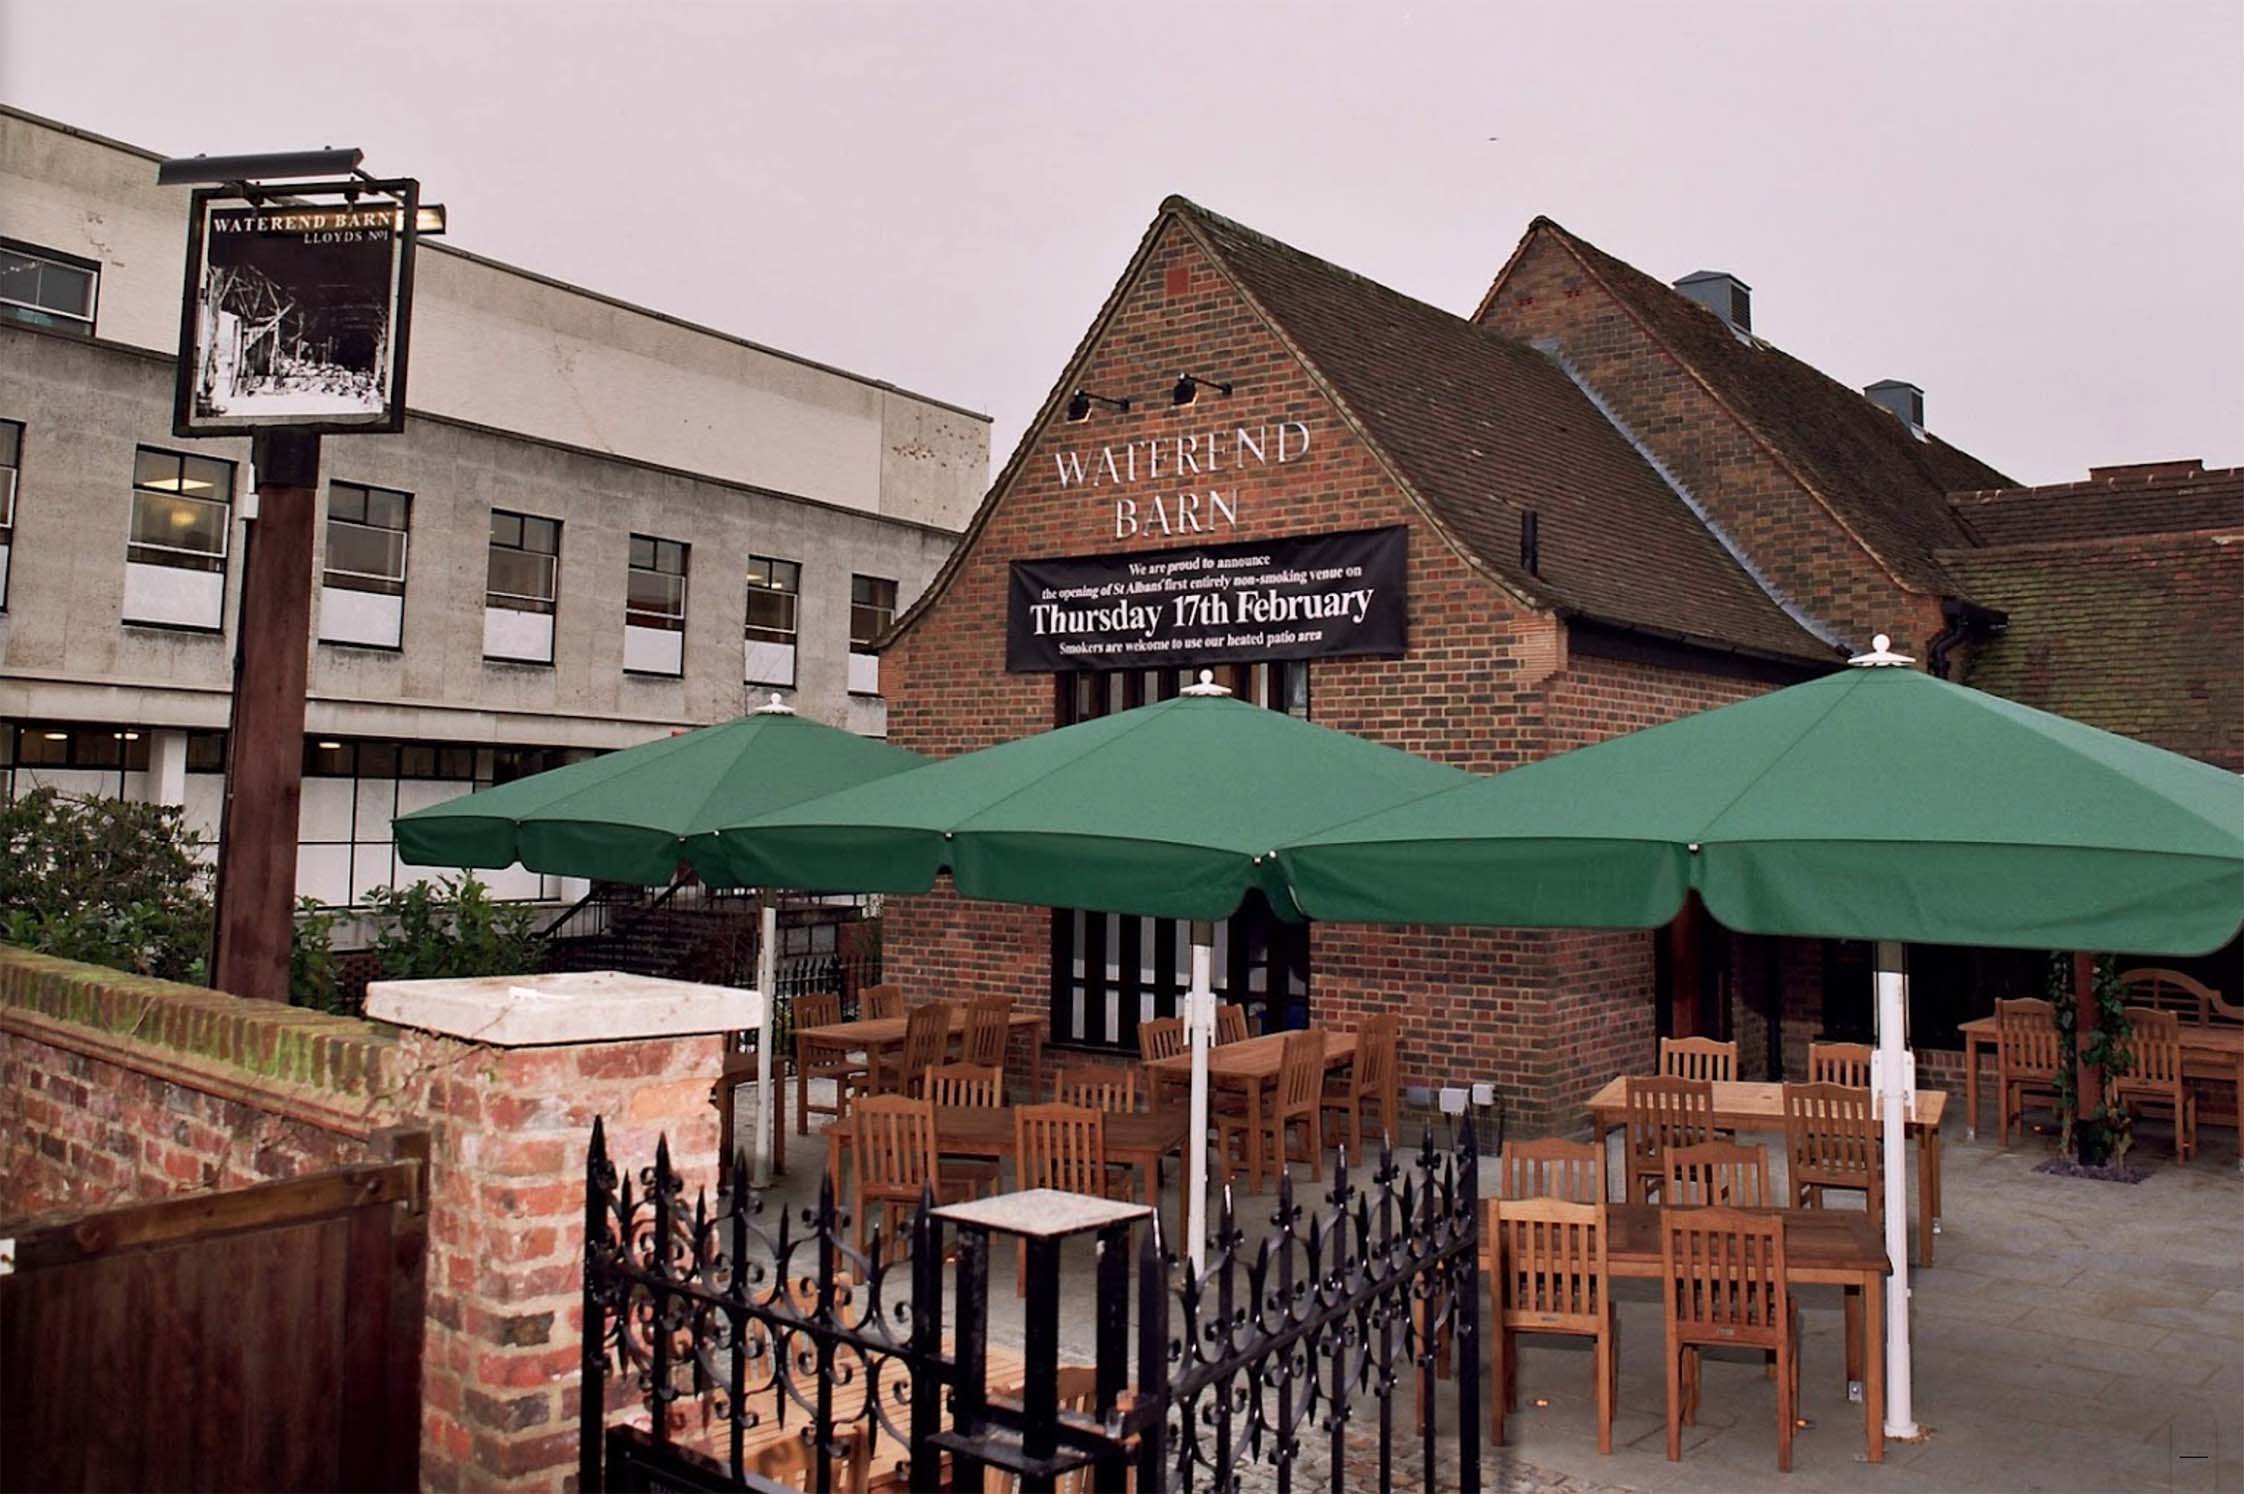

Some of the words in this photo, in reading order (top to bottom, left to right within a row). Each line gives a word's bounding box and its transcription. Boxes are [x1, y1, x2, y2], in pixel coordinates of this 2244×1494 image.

[214, 215, 326, 233] WATEREND
[335, 211, 391, 228] BARN
[304, 231, 362, 244] LLOYDS
[1055, 420, 1311, 488] WATEREND
[1115, 489, 1239, 539] BARN
[1129, 563, 1147, 576] We
[1148, 563, 1166, 575] are
[1167, 557, 1200, 576] proud
[1202, 557, 1214, 569] to
[1217, 555, 1271, 568] announce
[1042, 588, 1057, 600] the
[1058, 584, 1099, 601] opening
[1100, 583, 1112, 596] of
[1113, 582, 1125, 595] St
[1164, 577, 1187, 592] first
[1189, 574, 1231, 591] entirely
[1233, 568, 1308, 587] non-smoking
[1309, 567, 1344, 580] venue
[1345, 566, 1362, 578] on
[1030, 599, 1163, 637] Thursday
[1172, 593, 1229, 627] 17th
[1235, 588, 1374, 624] February
[1059, 641, 1103, 656] Smokers
[1104, 641, 1122, 653] are
[1125, 639, 1170, 653] welcome
[1171, 638, 1182, 650] to
[1184, 638, 1203, 650] use
[1204, 636, 1225, 648] our
[1227, 631, 1264, 647] heated
[1266, 630, 1296, 647] patio
[1297, 630, 1322, 642] area
